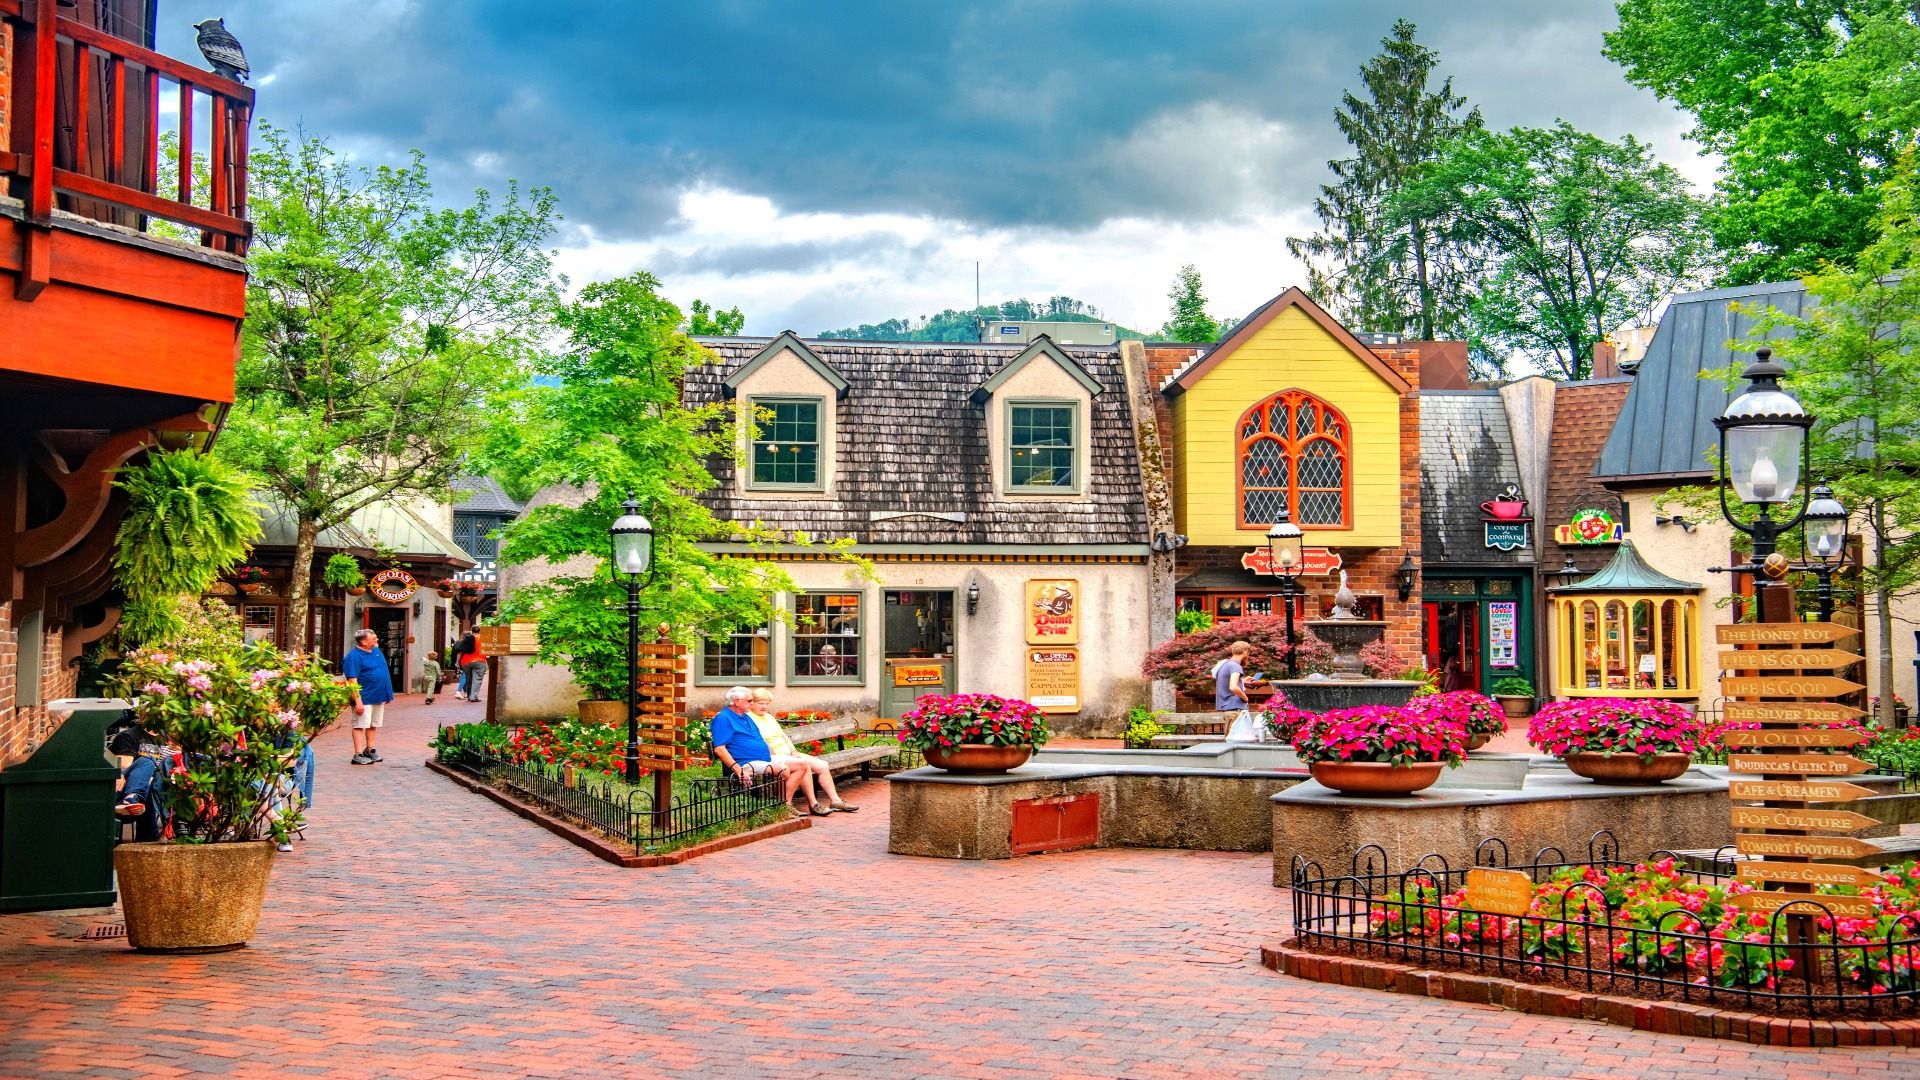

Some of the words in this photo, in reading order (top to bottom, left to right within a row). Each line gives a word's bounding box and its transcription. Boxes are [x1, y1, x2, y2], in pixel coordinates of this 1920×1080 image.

[1581, 509, 1604, 517] PEPPER
[1034, 613, 1073, 626] Donut
[1034, 625, 1069, 636] Friar
[1720, 629, 1746, 640] THE
[1751, 630, 1799, 640] HONEY
[1803, 629, 1831, 640] POT
[1762, 655, 1777, 665] IS
[1781, 654, 1832, 665] GOOD
[1726, 682, 1757, 694] LIFE
[1762, 683, 1776, 694] IS
[1778, 681, 1826, 694] GOOD
[1728, 708, 1754, 719] THE
[1757, 708, 1800, 720] SILVER
[1805, 709, 1839, 720] TREE
[1764, 733, 1831, 745] OLIVE
[1735, 759, 1790, 770] BOUDICCA'S
[1792, 760, 1825, 772] CELTIC
[1828, 761, 1848, 772] PUB
[1735, 783, 1765, 795] CAFE
[1766, 786, 1776, 795] &
[1776, 784, 1841, 797] CREAMERY
[1739, 812, 1769, 824] POP
[1774, 813, 1852, 828] CULTURE
[1741, 840, 1791, 854] COMFORT
[1794, 842, 1855, 856] FOOTWEAR
[1742, 866, 1797, 879] ESCAPE
[1801, 868, 1856, 882] GAMES
